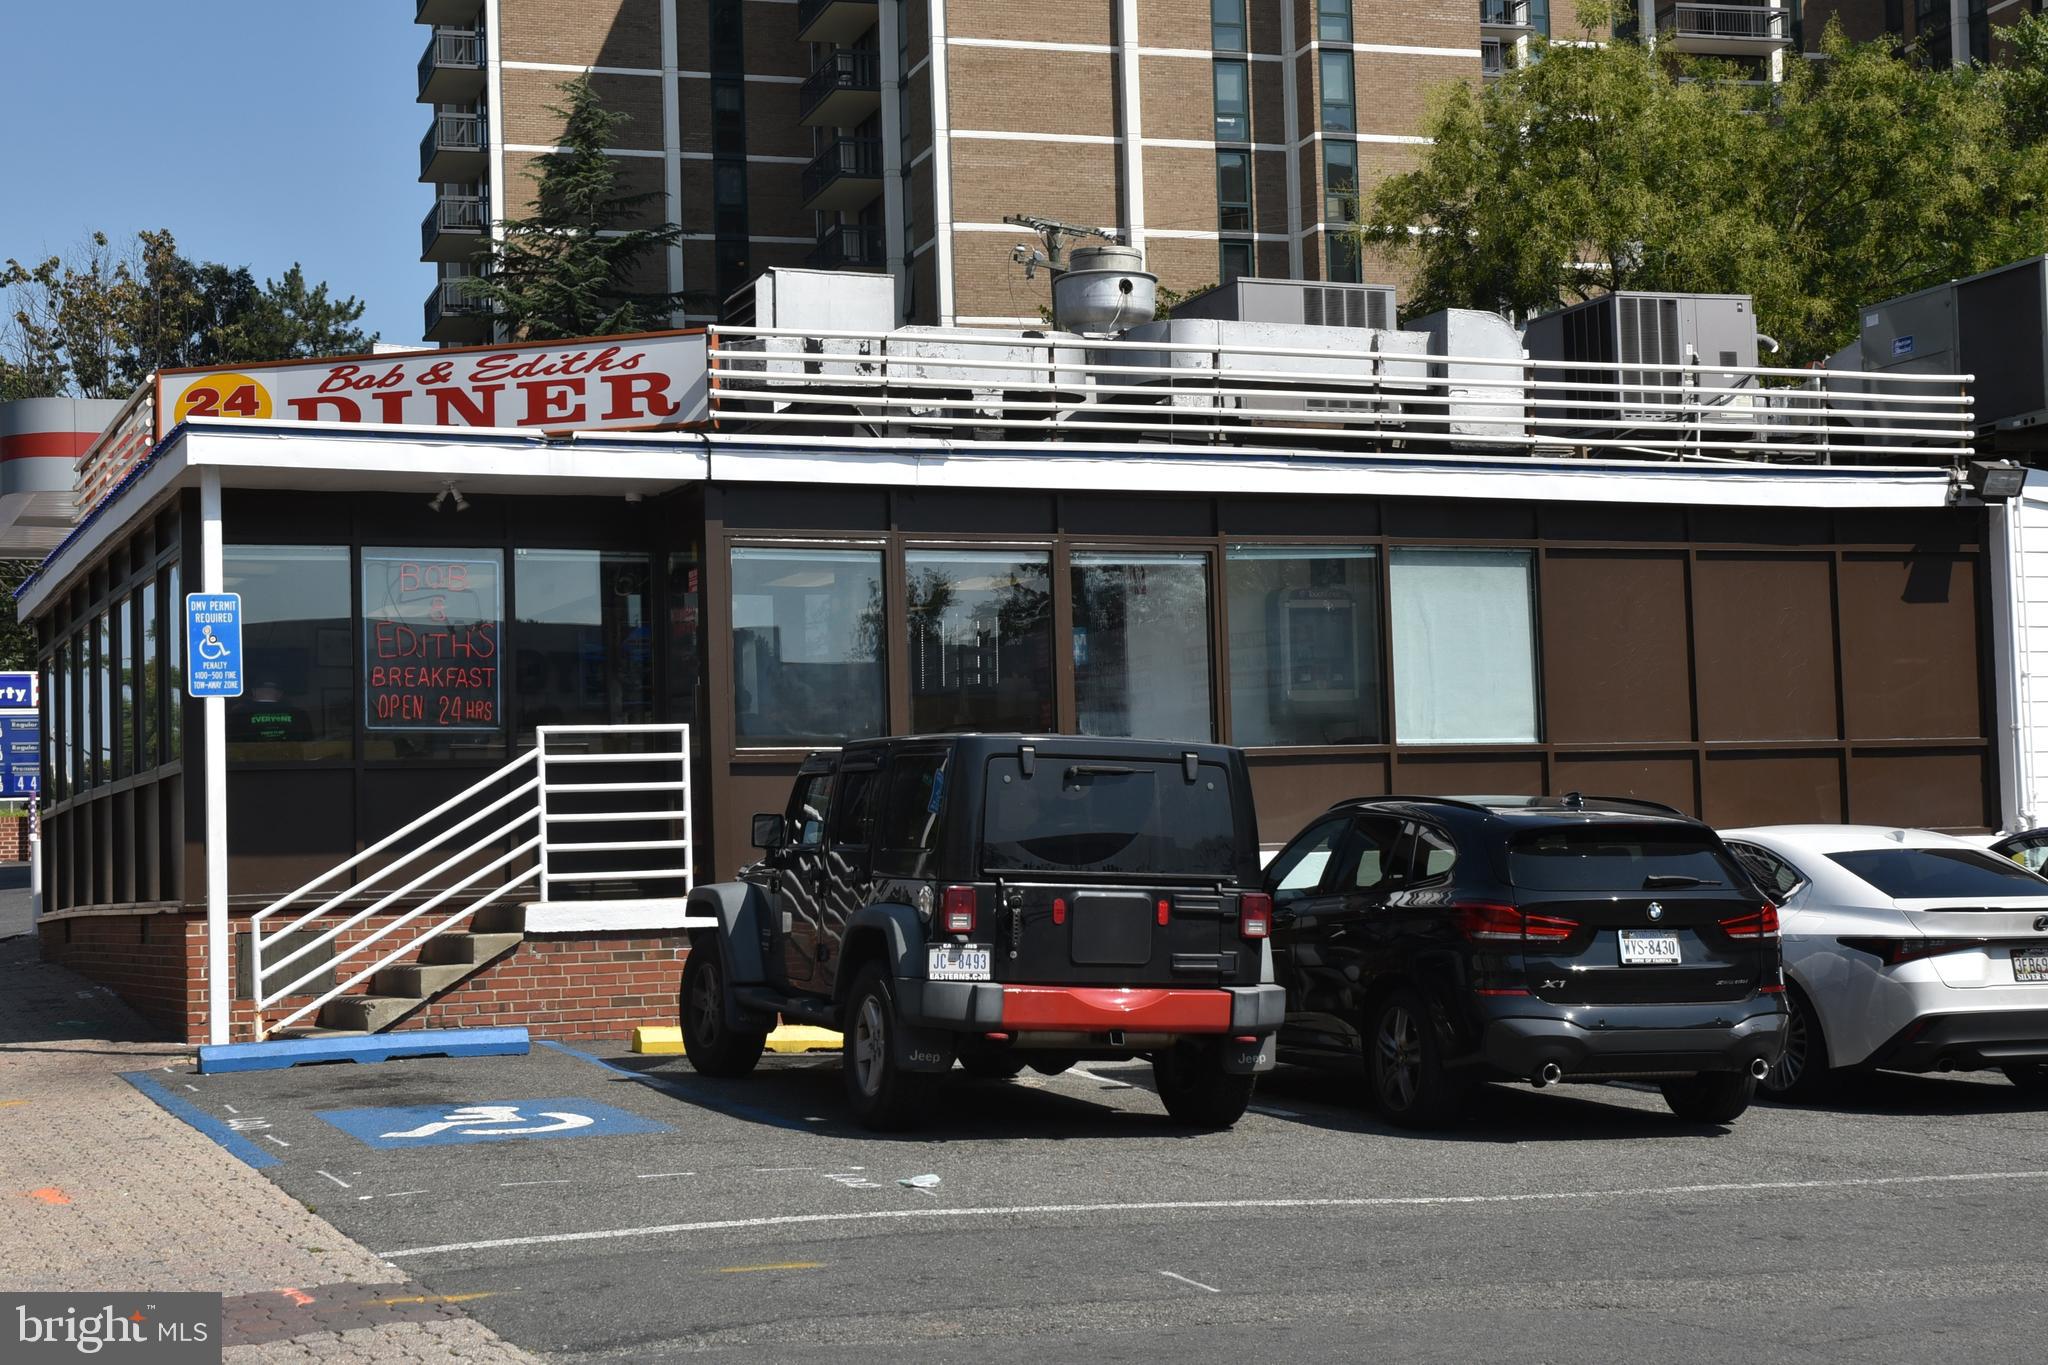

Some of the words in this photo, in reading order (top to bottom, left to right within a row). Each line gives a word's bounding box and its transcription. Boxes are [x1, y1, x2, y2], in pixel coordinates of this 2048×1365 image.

[317, 365, 405, 394] Bob
[416, 360, 455, 386] &
[468, 346, 646, 383] Ediths
[184, 384, 261, 417] 24
[288, 372, 680, 426] DINER
[400, 563, 469, 592] BOB
[191, 601, 206, 611] DMV
[209, 601, 237, 611] PERMIT
[195, 613, 233, 623] REQUIRED
[202, 661, 228, 670] PENALTY
[225, 671, 237, 679] FINE
[371, 666, 497, 688] BREAKFAST
[194, 681, 222, 690] TOW-AWAY
[224, 680, 239, 689] ZONE
[378, 694, 424, 720] OPEN
[439, 695, 462, 725] 24
[466, 700, 493, 721] HRS
[1540, 979, 1566, 989] X1
[910, 1049, 941, 1064] Jeep
[1238, 1053, 1266, 1065] Jeep
